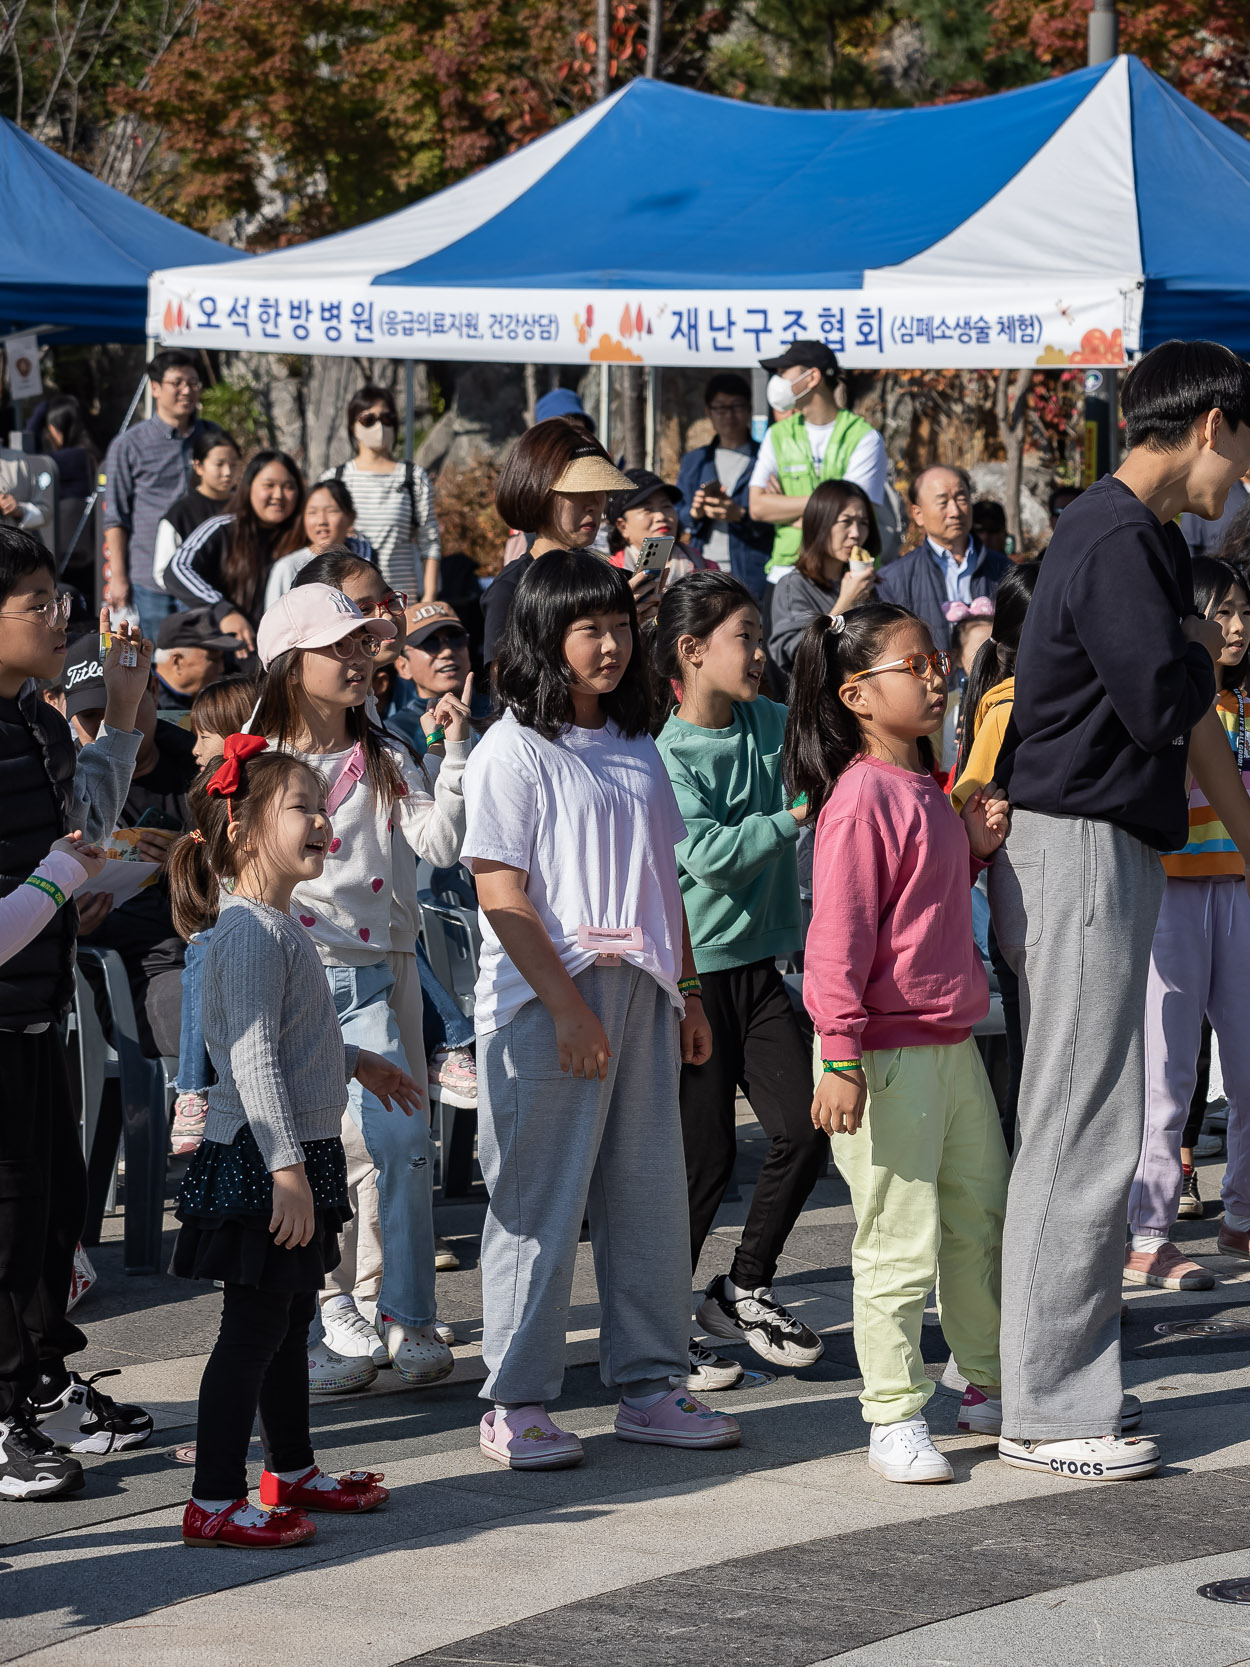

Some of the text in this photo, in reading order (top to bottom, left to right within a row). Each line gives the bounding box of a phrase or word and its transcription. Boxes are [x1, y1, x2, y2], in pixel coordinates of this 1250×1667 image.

[197, 296, 375, 343] 오석한방병원
[671, 307, 1043, 353] 재난구조협회 (심폐소생술 체험)
[65, 660, 104, 689] Title
[1049, 1458, 1104, 1476] crocs
